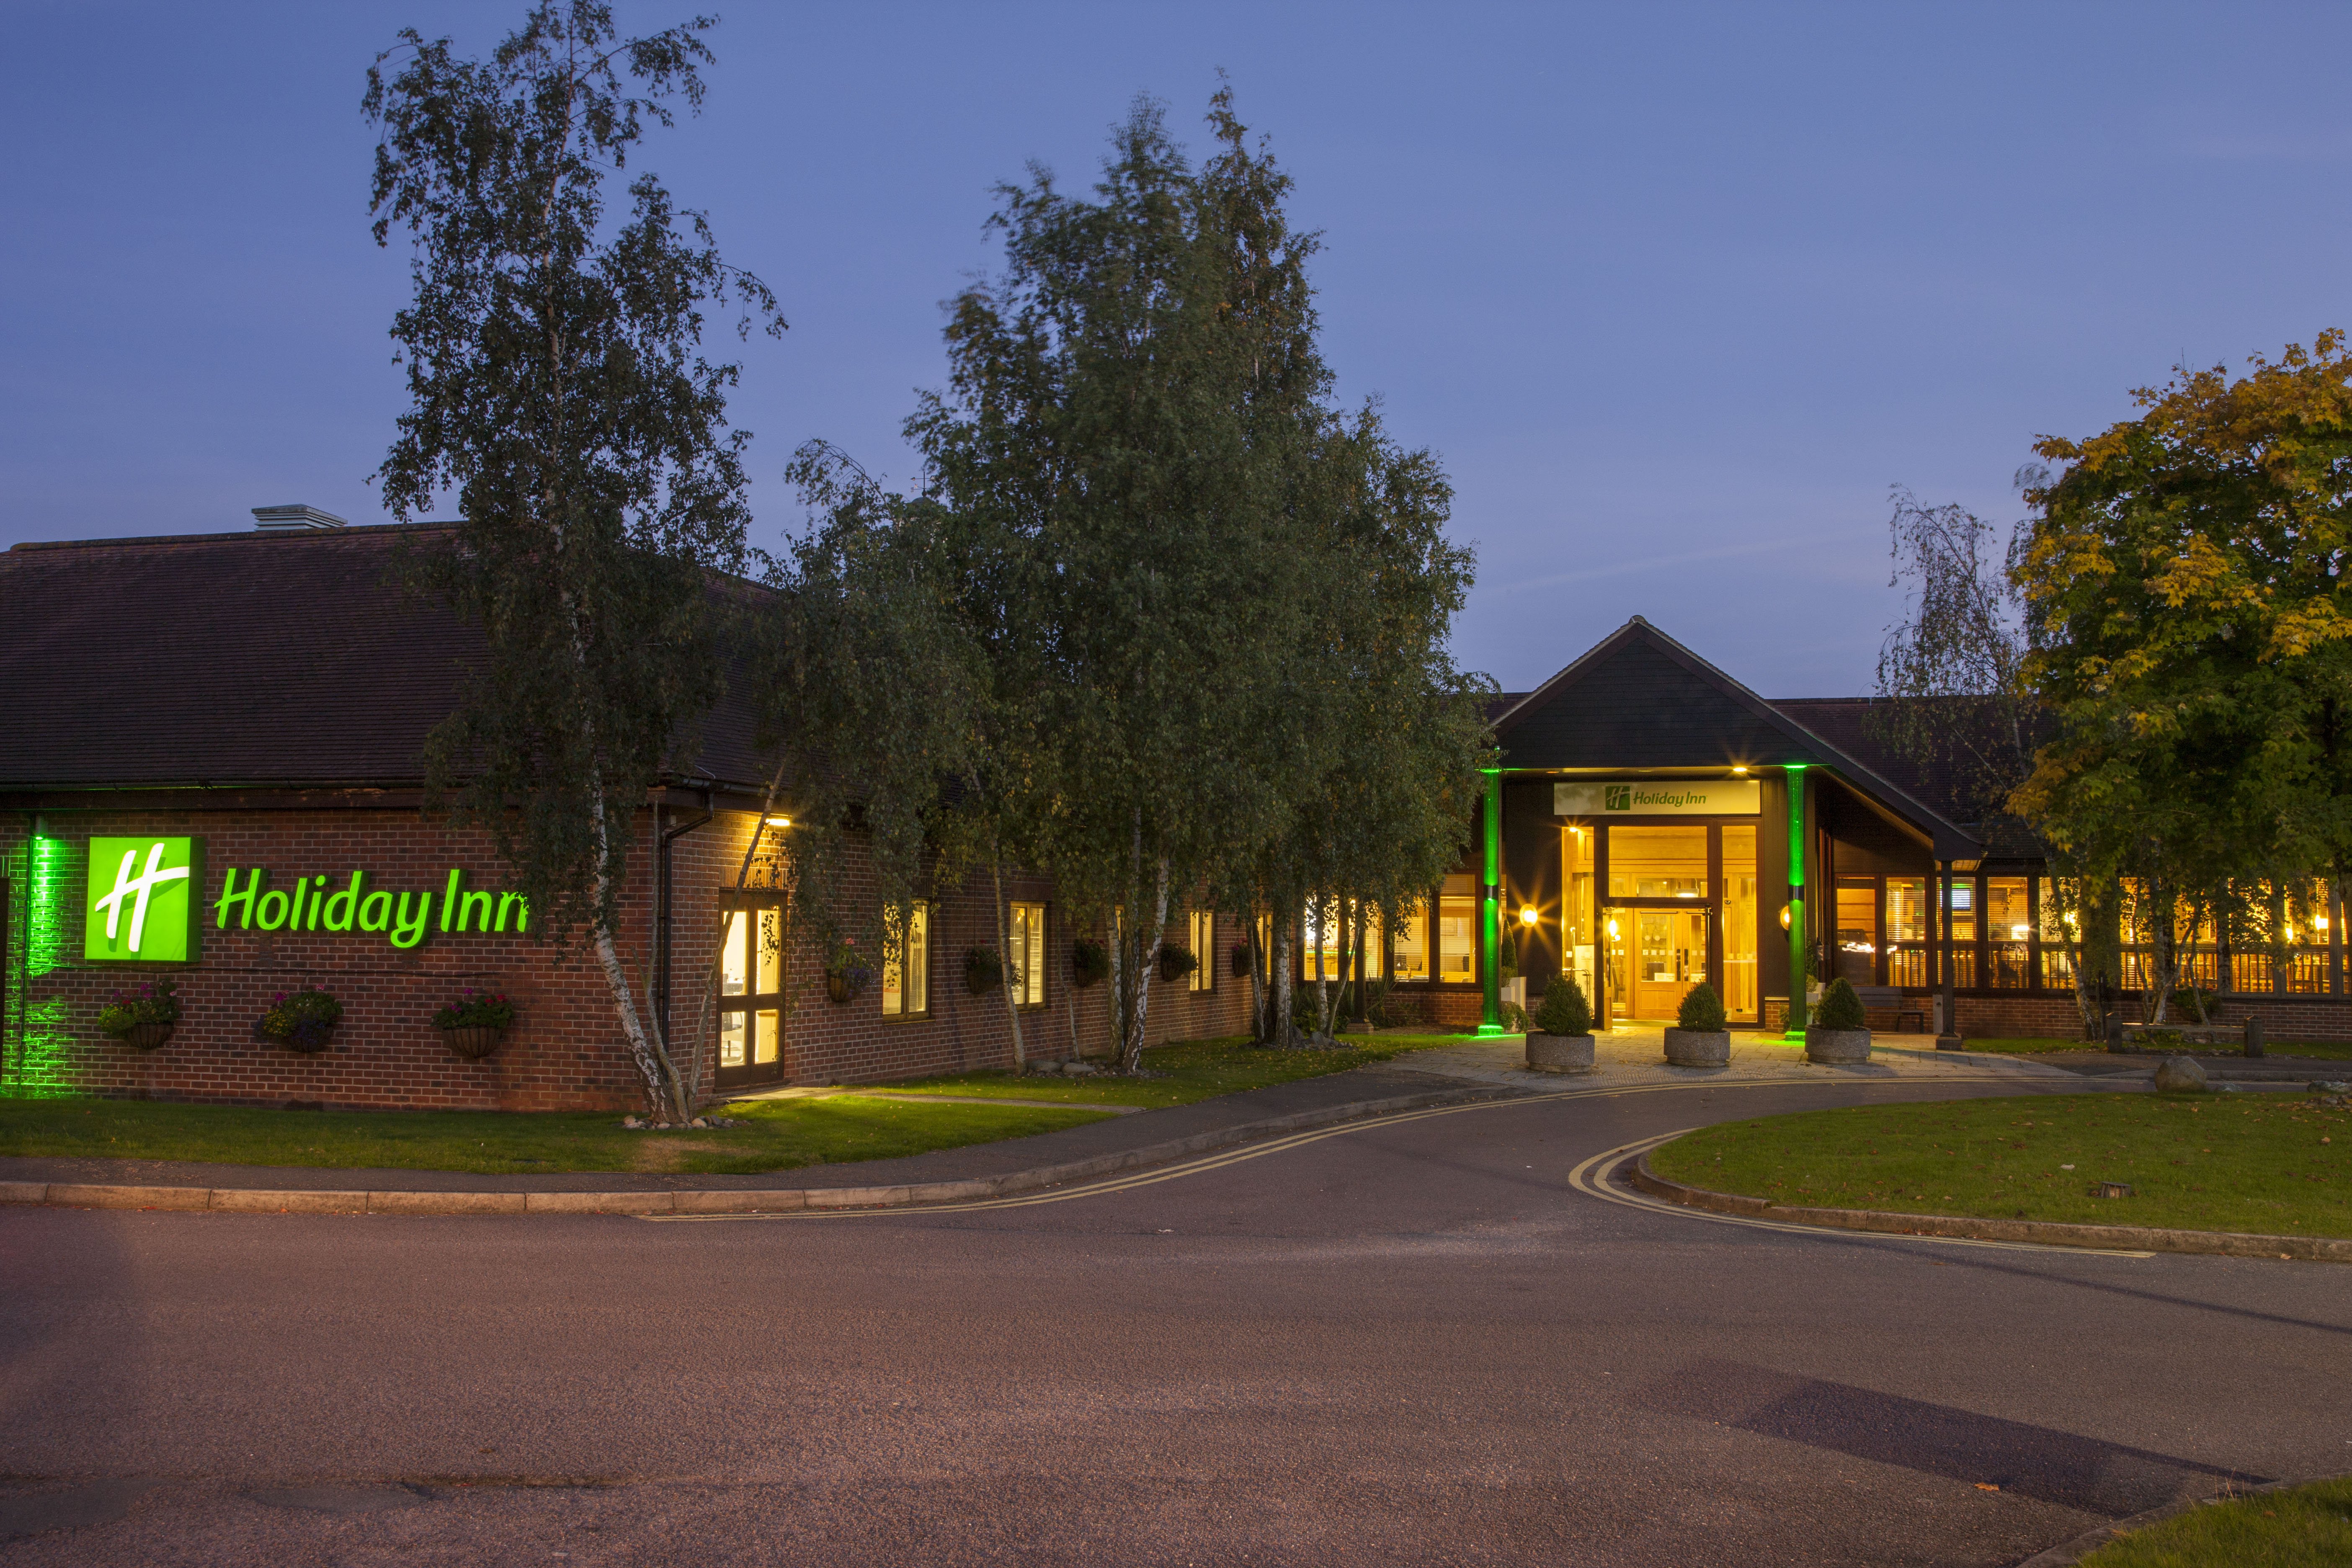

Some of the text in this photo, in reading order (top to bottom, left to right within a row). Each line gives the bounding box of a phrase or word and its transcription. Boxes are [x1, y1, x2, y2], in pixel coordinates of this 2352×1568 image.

[1633, 791, 1706, 807] Holiday Inn
[95, 843, 190, 952] H
[214, 868, 529, 948] Holiday Inn
